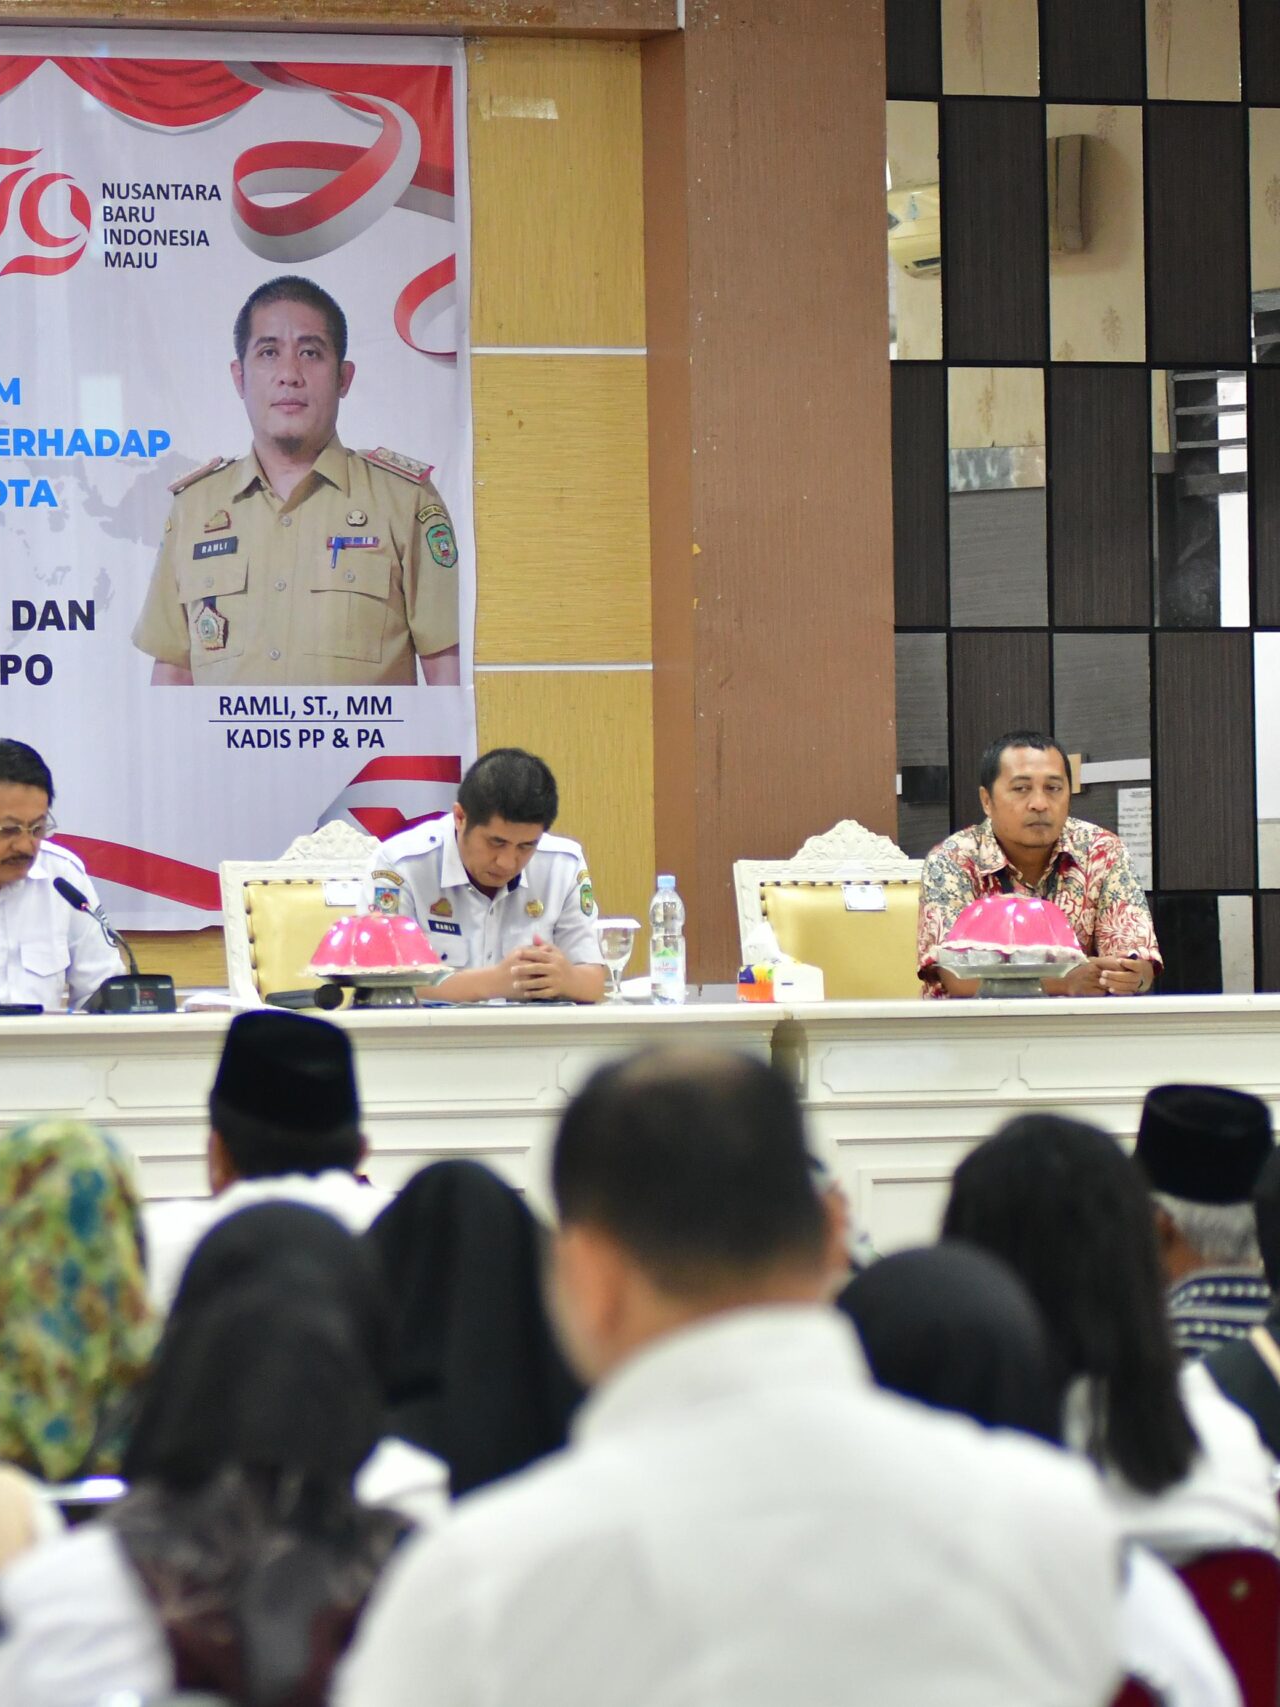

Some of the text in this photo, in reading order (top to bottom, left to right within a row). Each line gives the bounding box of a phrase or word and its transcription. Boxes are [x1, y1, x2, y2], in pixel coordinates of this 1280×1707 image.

[101, 182, 222, 202] NUSANTARA
[102, 205, 155, 223] BARU
[103, 228, 210, 247] INDONESIA
[104, 251, 158, 269] MAJU
[201, 541, 228, 554] RAMLI
[11, 599, 96, 632] DAN
[219, 695, 392, 720] RAMLI, ST., MM
[226, 727, 385, 749] KADIS PP & PA
